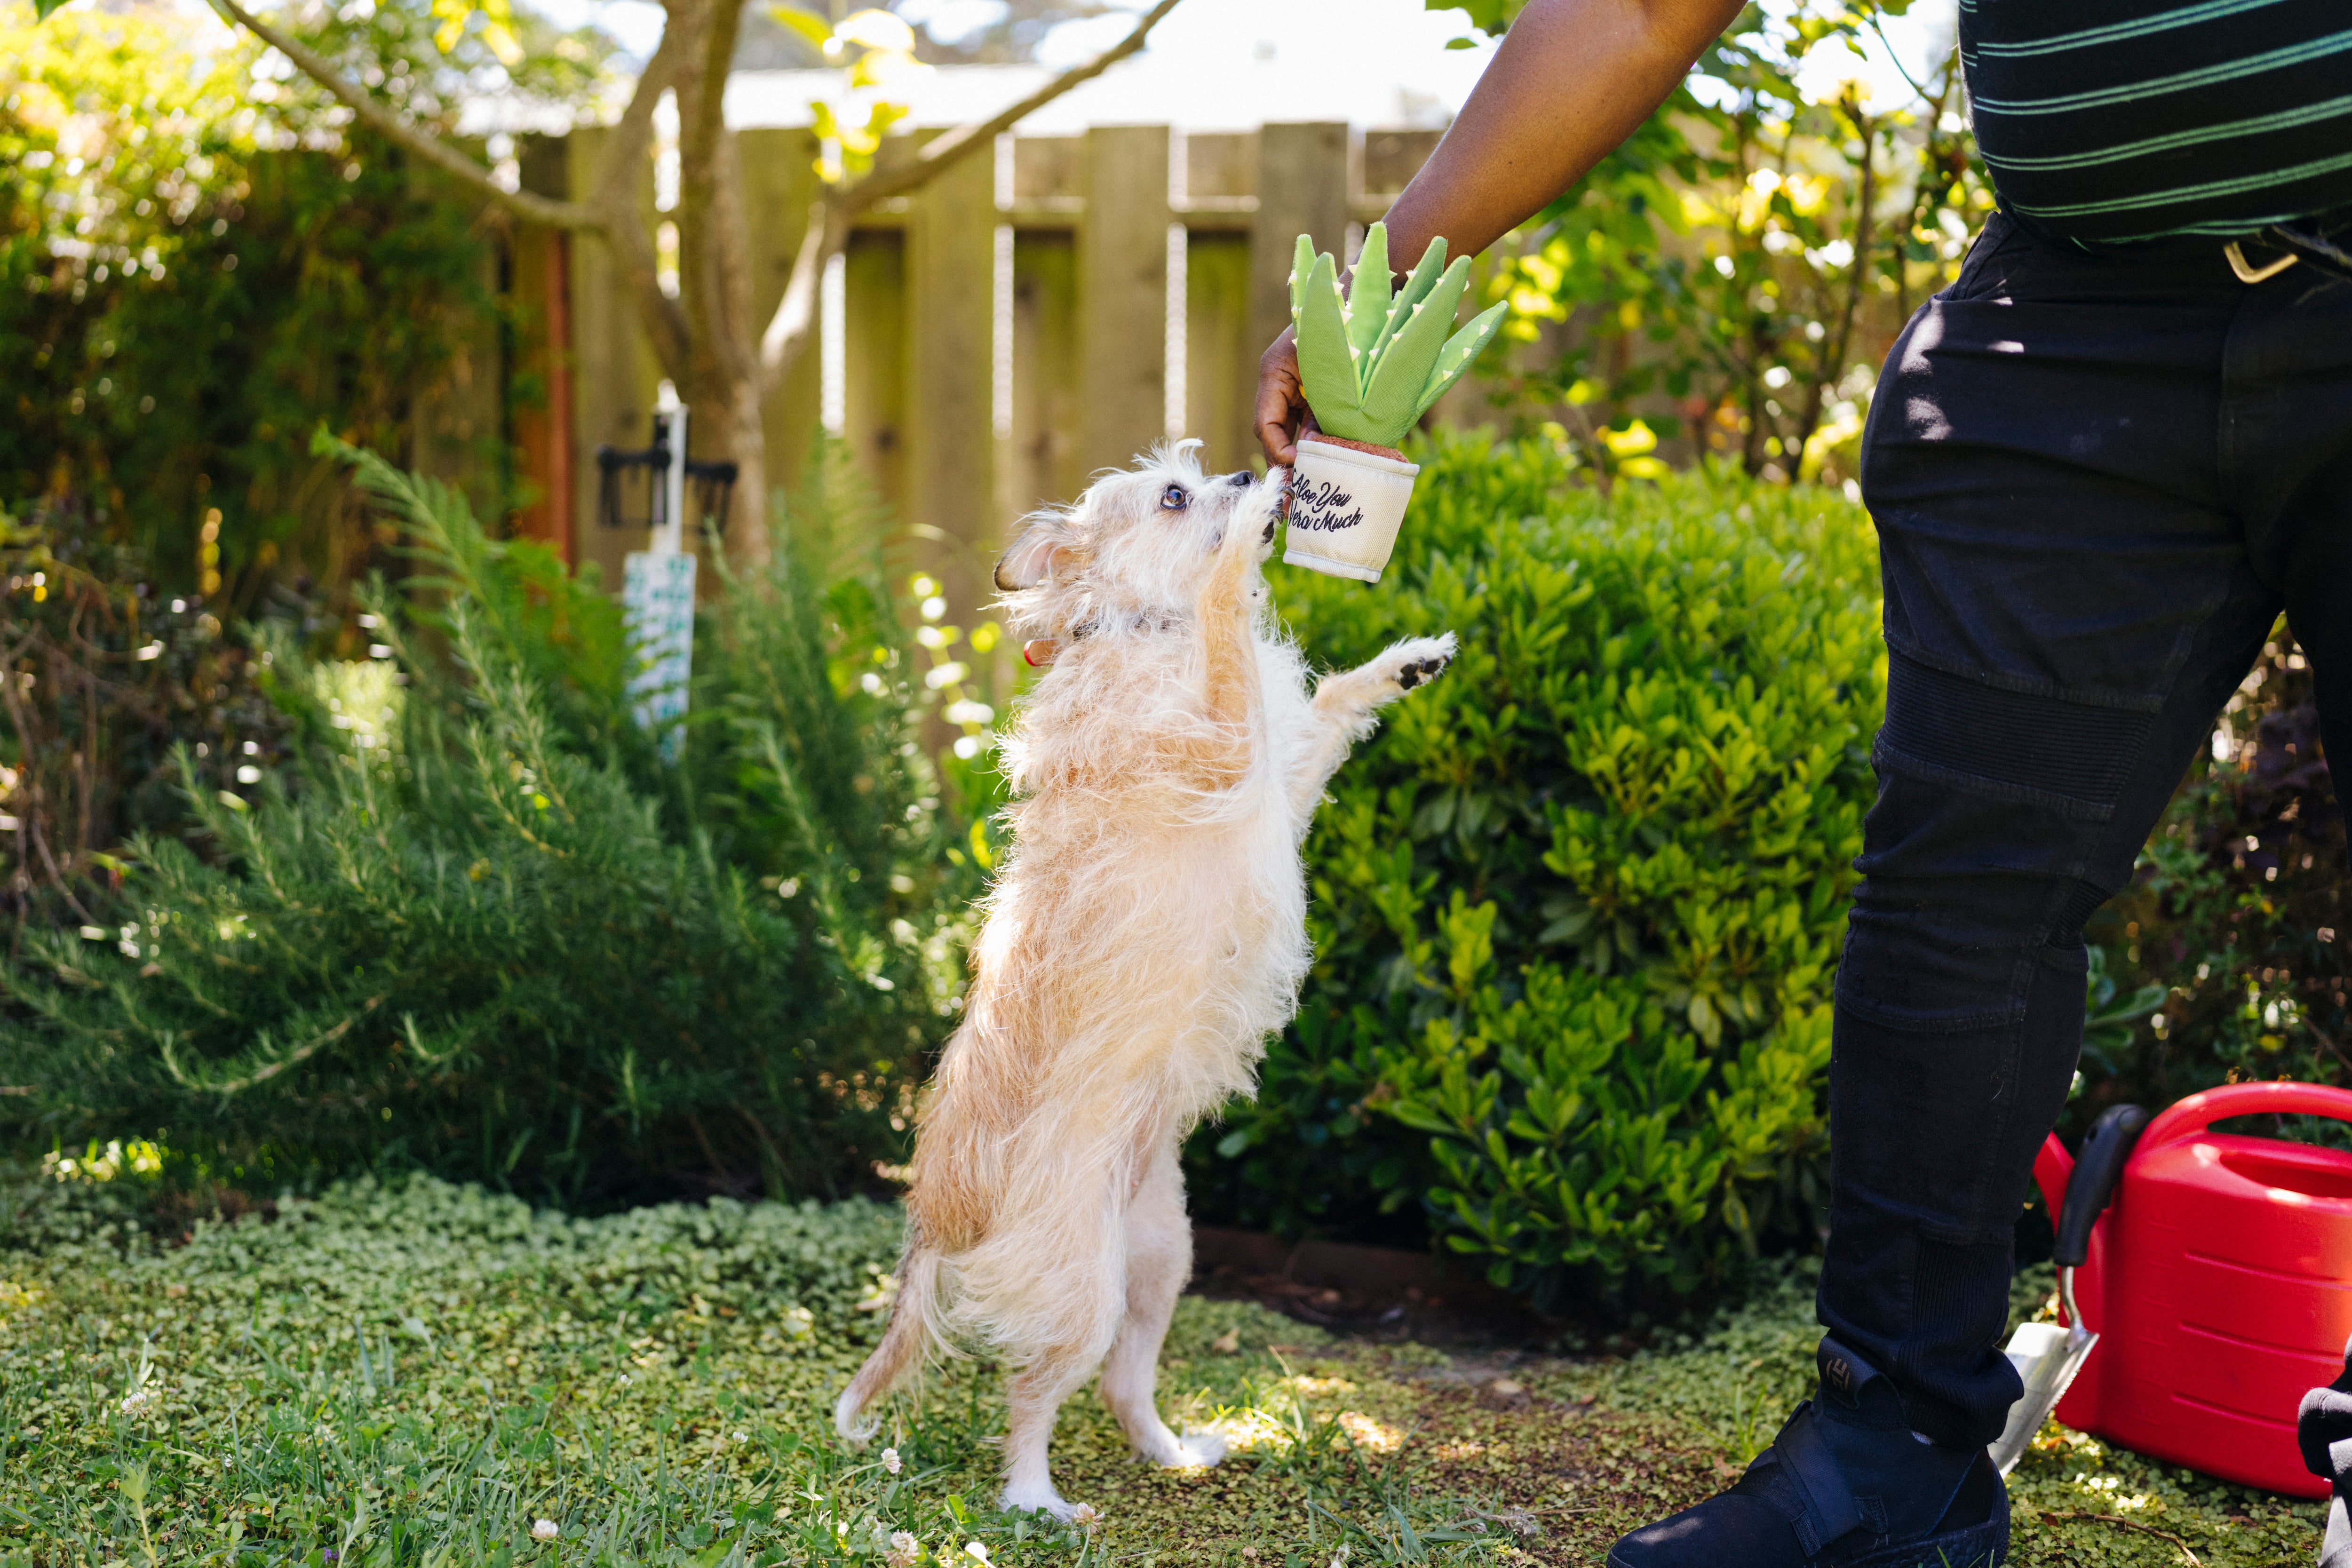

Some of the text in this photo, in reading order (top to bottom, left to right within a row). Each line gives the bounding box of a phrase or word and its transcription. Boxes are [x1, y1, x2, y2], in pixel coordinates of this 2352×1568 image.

[1292, 468, 1352, 514] Aloe You
[1288, 499, 1363, 532] Vera Much
